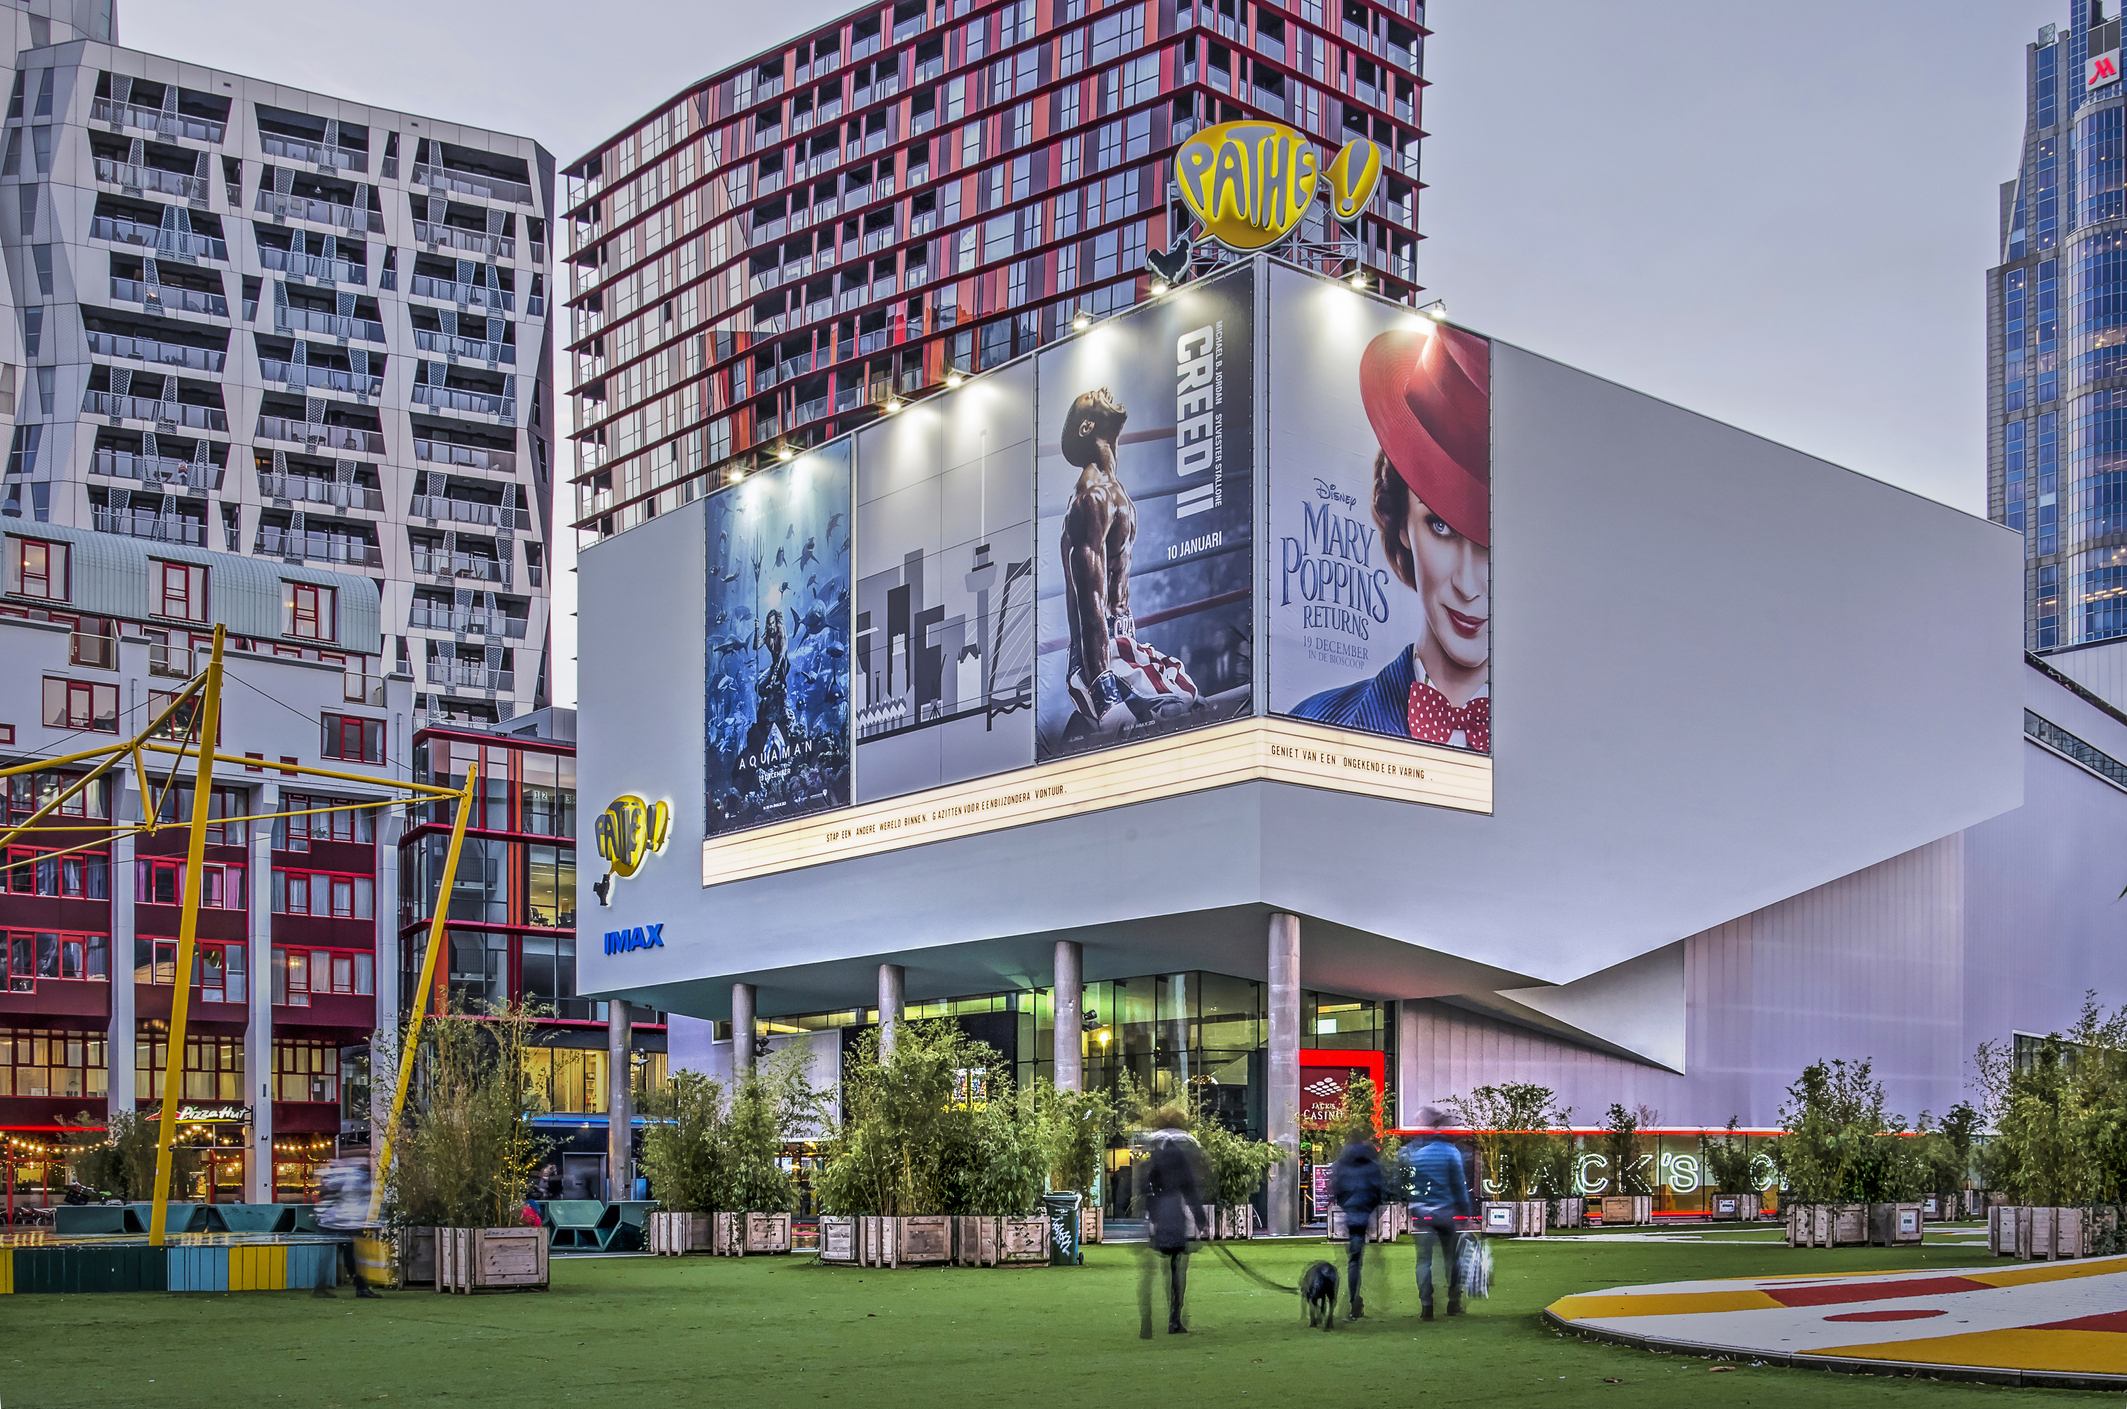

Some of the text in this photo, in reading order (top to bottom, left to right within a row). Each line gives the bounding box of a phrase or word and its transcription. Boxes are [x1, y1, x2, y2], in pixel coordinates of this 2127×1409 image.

[1215, 320, 1223, 361] MICHAEL
[1215, 371, 1223, 405] JORDAN
[1176, 324, 1215, 520] CREED II
[1214, 413, 1223, 462] SYLVESTER
[1214, 462, 1223, 508] STALLONE
[1167, 530, 1222, 561] 10 JANUARI
[1301, 500, 1376, 569] MARY
[1280, 537, 1390, 624] POPPINS
[1302, 605, 1370, 641] RETURNS
[1303, 635, 1369, 660] 19 DECEMBER
[1308, 649, 1365, 670] IN DE BIOSCOOP
[738, 739, 813, 771] AQUAMAN
[1271, 744, 1299, 759] GENIET
[1302, 750, 1317, 762] VAN
[1320, 752, 1336, 765] EEN
[826, 831, 839, 843] STAP
[841, 829, 852, 840] EEN
[856, 824, 876, 836] ANDERE
[879, 818, 902, 831] WERELD
[963, 803, 980, 814] VOOR
[604, 922, 665, 956] IMAX
[179, 1105, 250, 1121] Pizza Hut
[1303, 1109, 1344, 1121] CASINO
[1311, 1101, 1336, 1110] JACK'S
